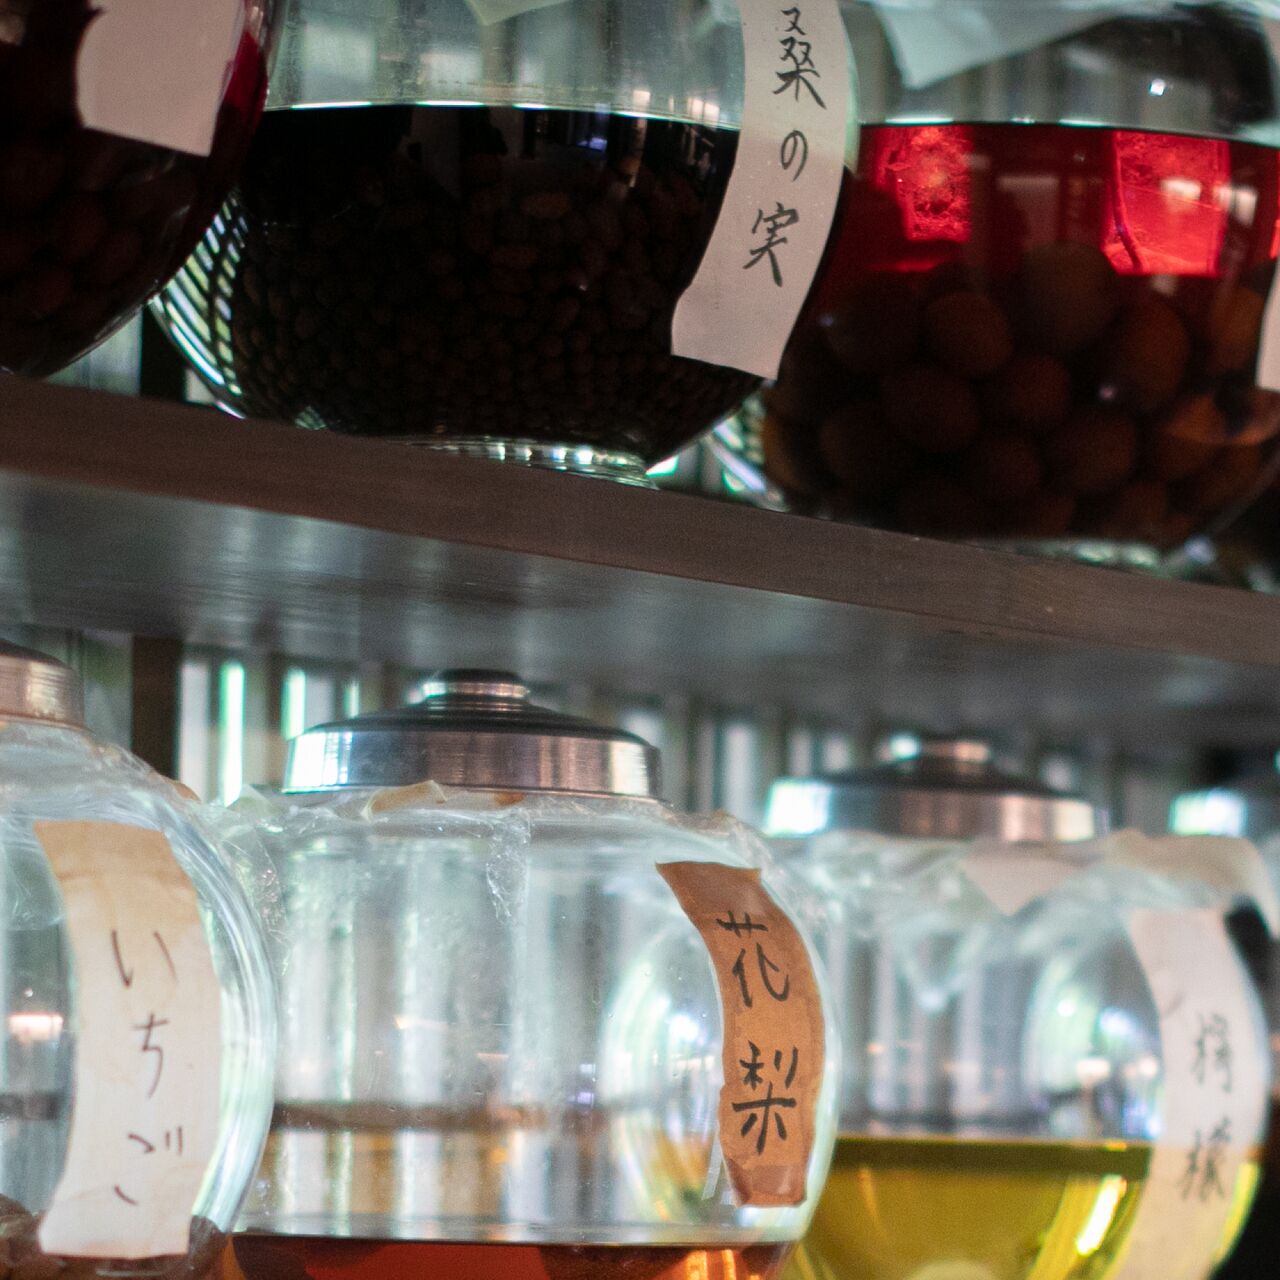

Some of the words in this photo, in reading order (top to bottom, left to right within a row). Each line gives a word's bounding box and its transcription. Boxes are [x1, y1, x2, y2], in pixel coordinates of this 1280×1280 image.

[742, 6, 827, 288] 桑の実
[111, 928, 184, 1207] いちご
[715, 909, 799, 1157] 花梨
